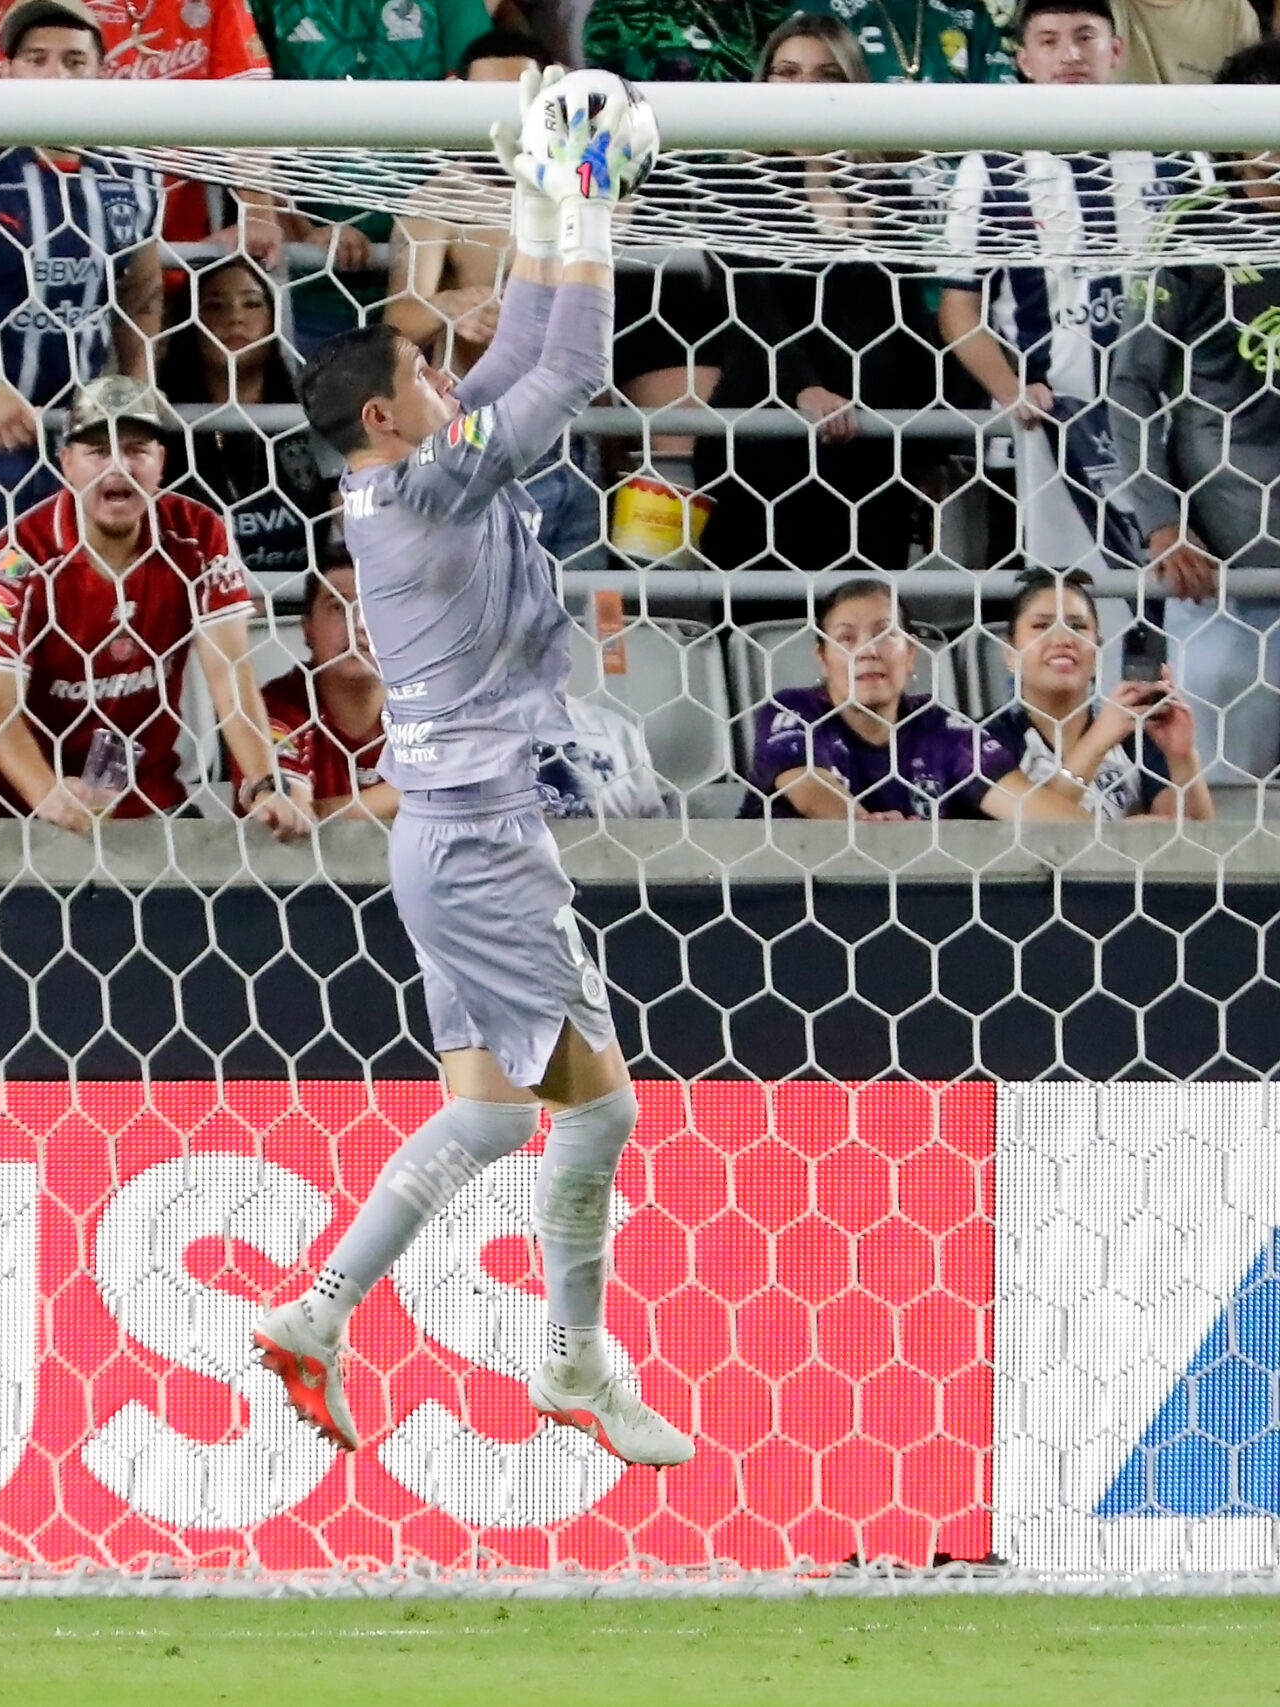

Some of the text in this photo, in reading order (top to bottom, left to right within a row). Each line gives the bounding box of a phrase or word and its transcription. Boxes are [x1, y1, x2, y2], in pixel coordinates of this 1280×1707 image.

[575, 160, 592, 199] 1
[33, 260, 101, 285] BBVA
[553, 904, 585, 966] 1
